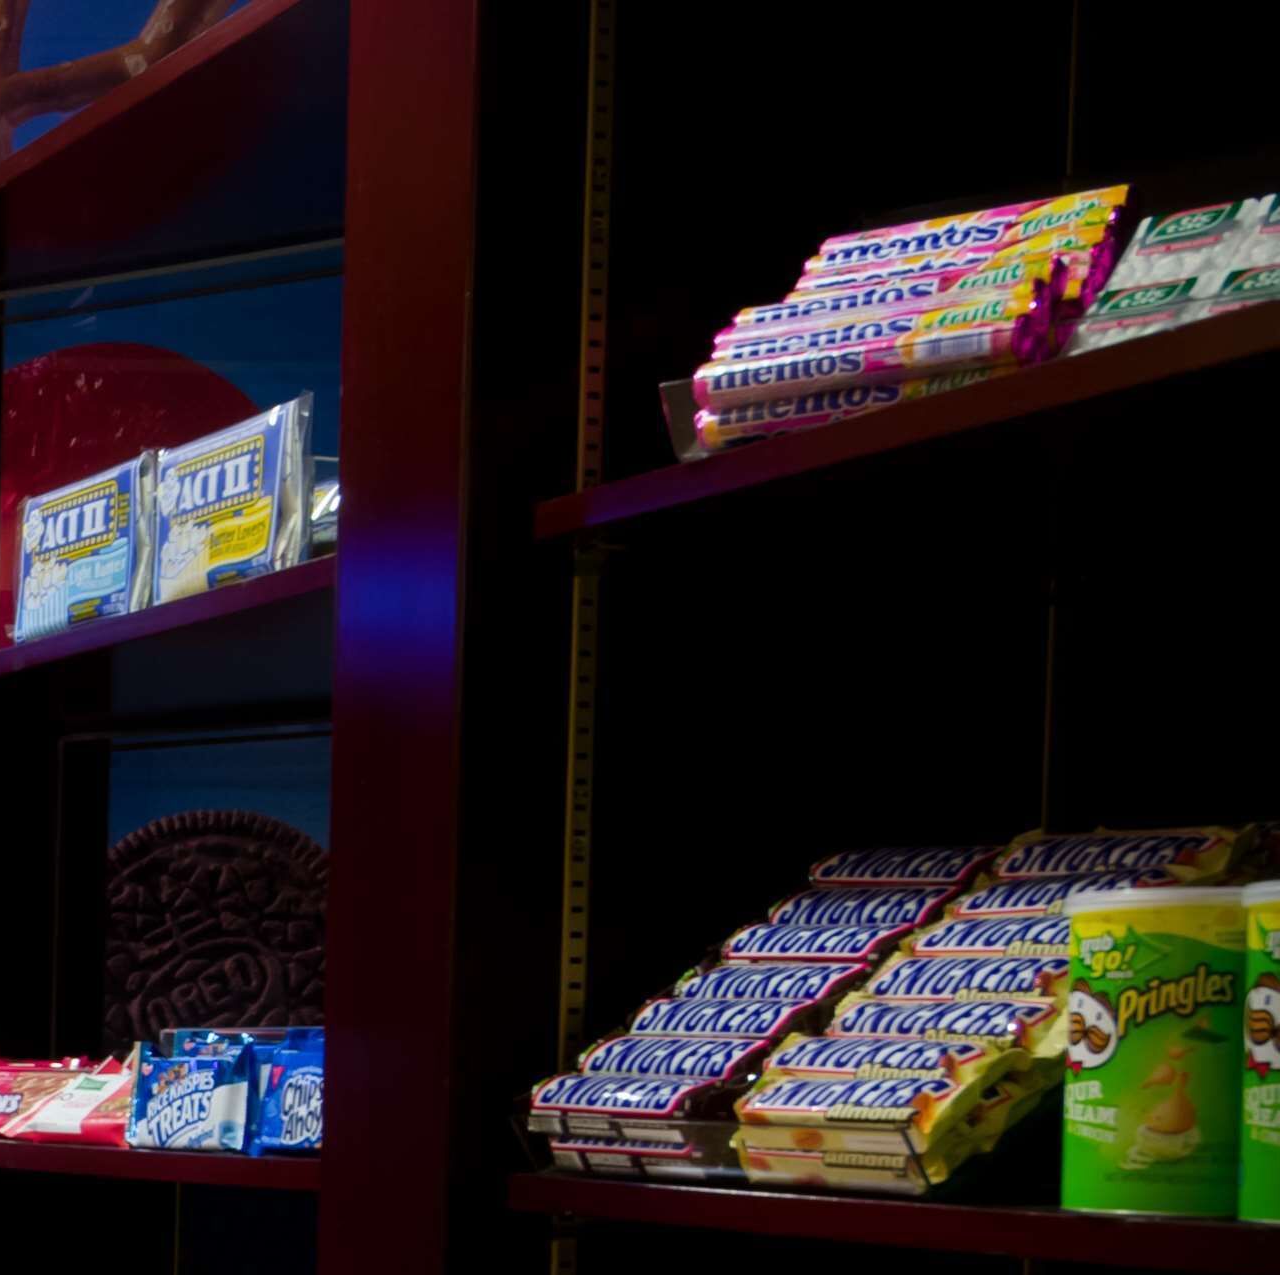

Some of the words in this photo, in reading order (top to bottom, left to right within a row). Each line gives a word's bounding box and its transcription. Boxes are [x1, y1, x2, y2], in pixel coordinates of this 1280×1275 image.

[754, 281, 935, 323] mentos
[711, 351, 864, 391] mentos
[924, 916, 1070, 946] SNICKER
[1117, 963, 1235, 1040] Pringles
[1064, 1079, 1103, 1102] OUR
[149, 1092, 214, 1145] TREATS
[282, 1107, 325, 1142] Ahoy
